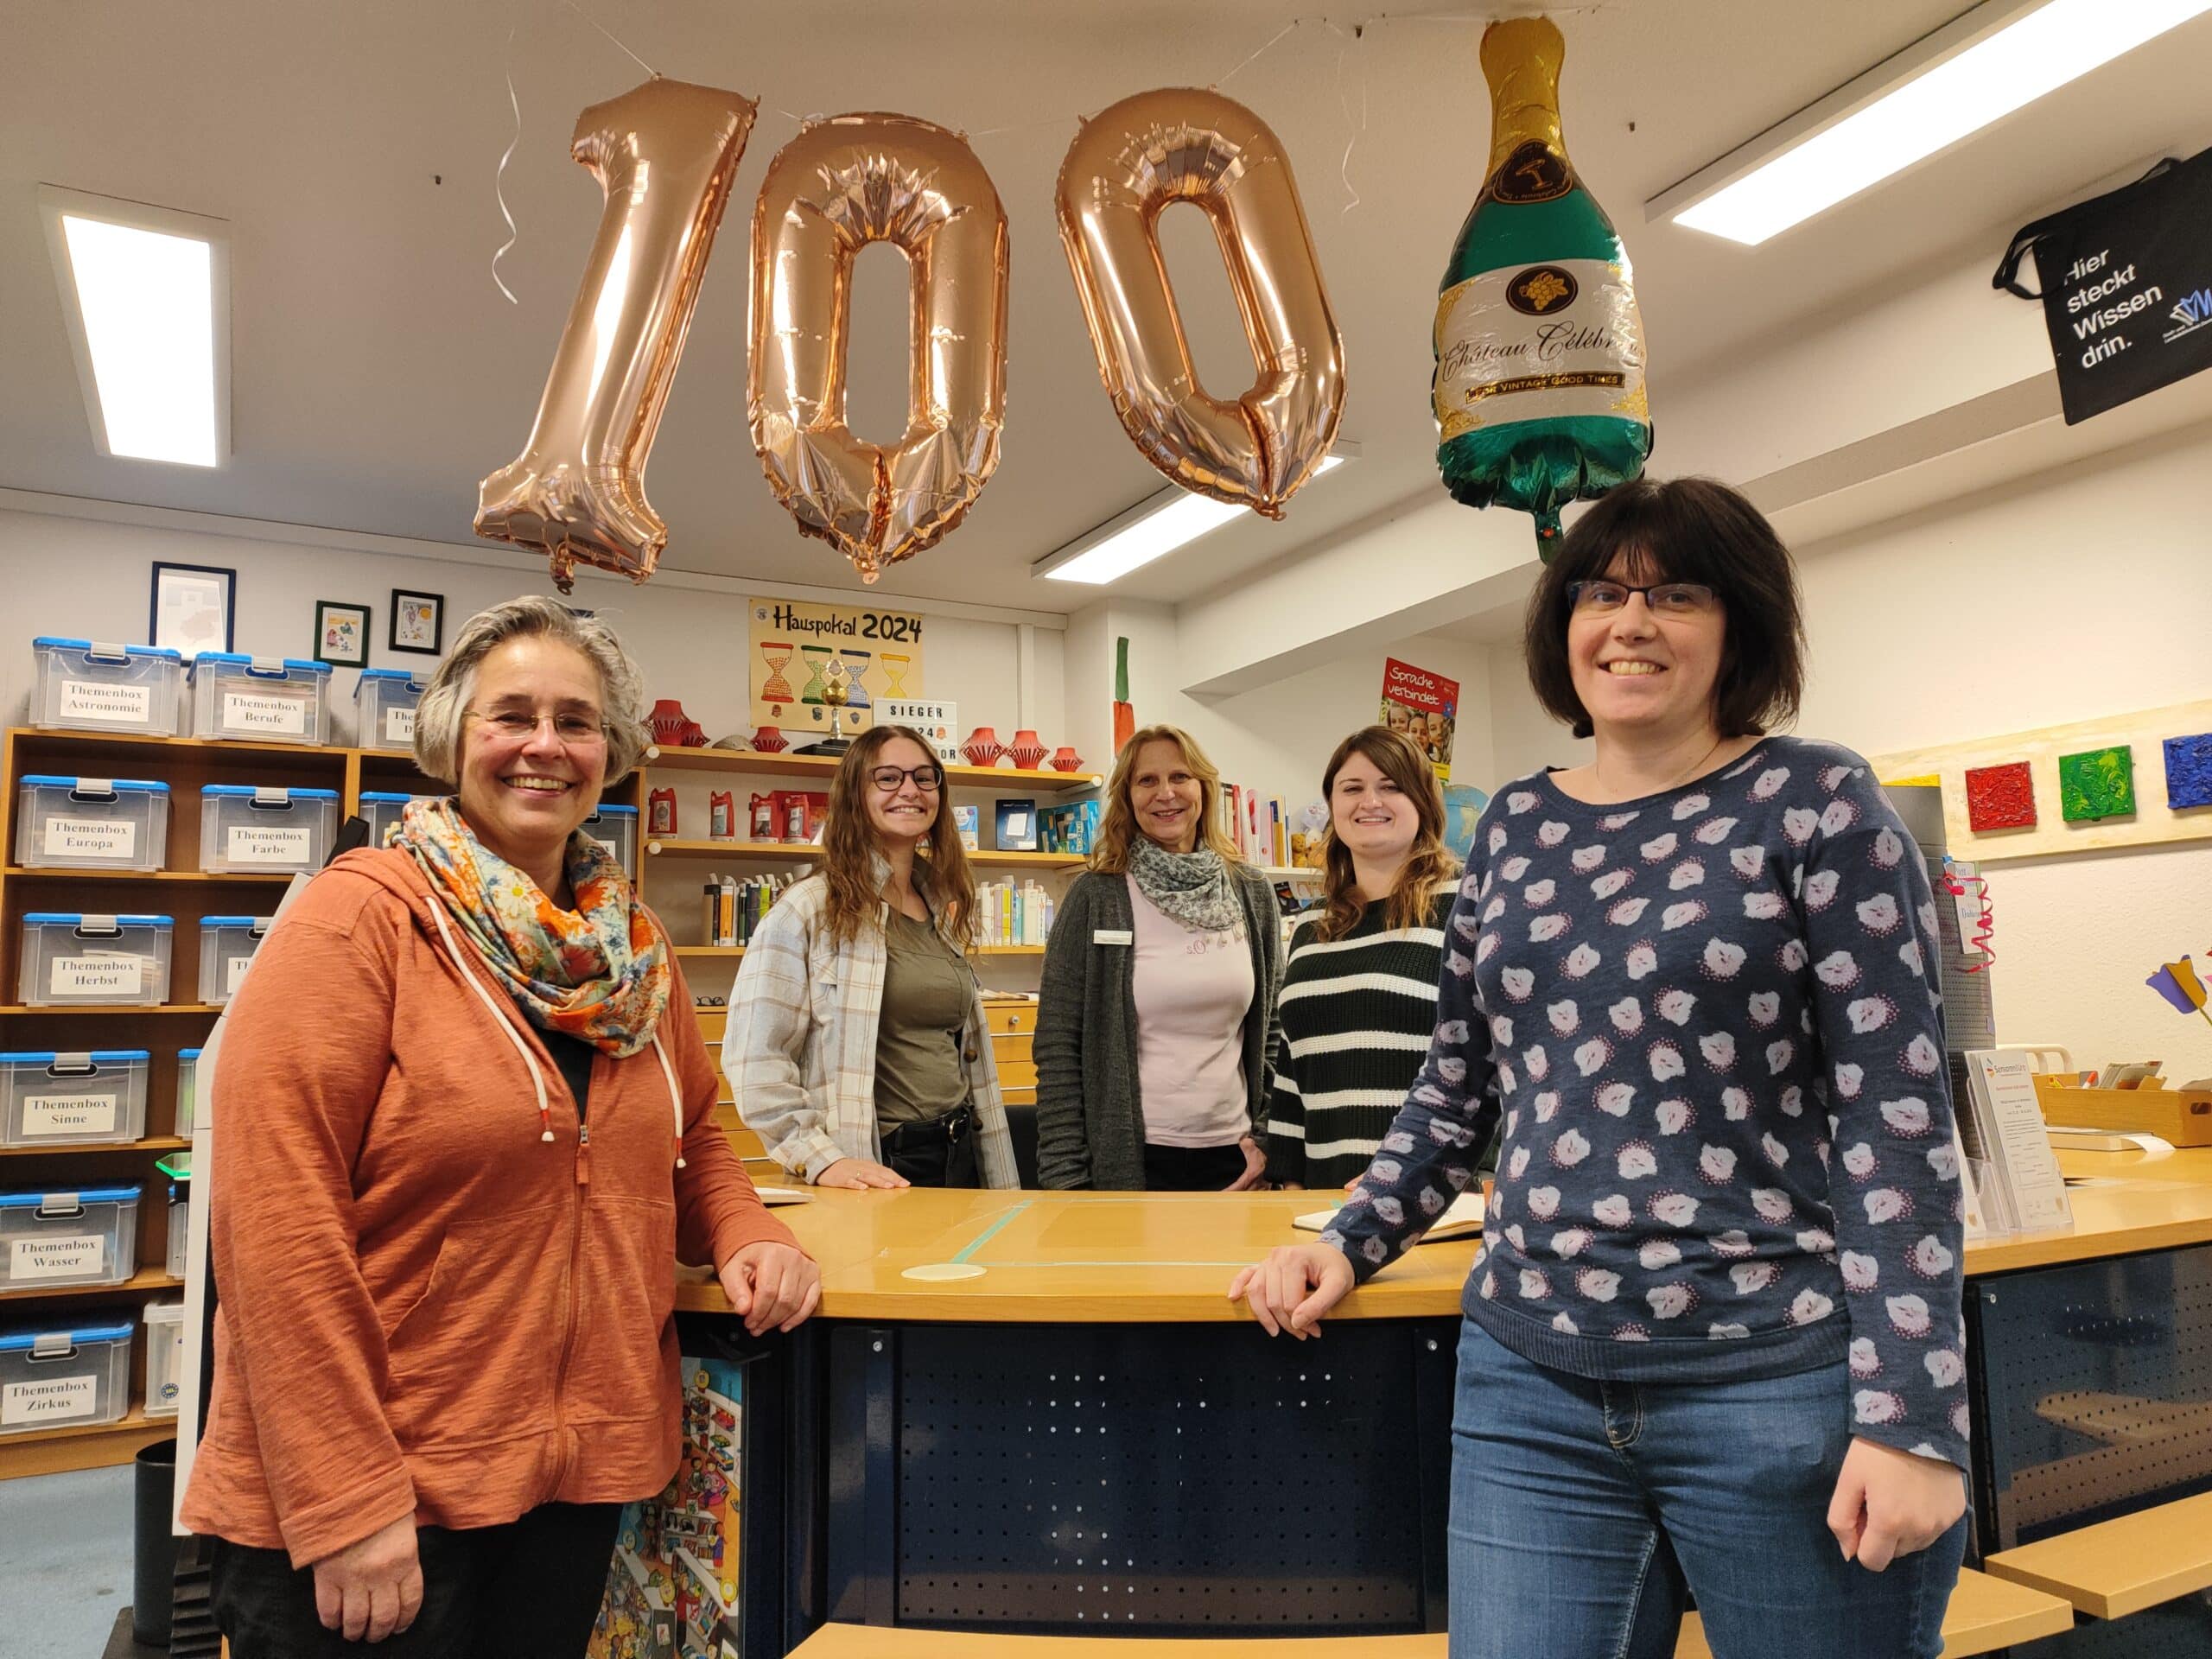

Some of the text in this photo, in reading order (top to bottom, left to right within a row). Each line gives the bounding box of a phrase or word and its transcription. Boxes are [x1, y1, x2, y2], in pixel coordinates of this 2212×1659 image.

[2063, 250, 2109, 286] Hier
[2067, 264, 2136, 314] steckt
[2073, 286, 2162, 340] Wissen
[2082, 335, 2133, 369] drin.
[1441, 340, 1528, 382] Château
[1551, 376, 1584, 385] GOOD
[772, 605, 856, 639] Hauspokal
[862, 613, 922, 643] 2024
[1389, 666, 1436, 690] Sprache
[68, 684, 143, 700] Themenbox
[1388, 683, 1440, 706] verbindet
[230, 696, 299, 712] Themenbox
[245, 711, 284, 725] Berufe
[890, 705, 943, 719] SIEGER
[53, 821, 128, 836] Themenbox
[66, 836, 114, 850] Europa
[234, 830, 303, 842] Themenbox
[251, 842, 287, 855] Farbe
[60, 960, 134, 971] Themenbox
[75, 975, 118, 985] Herbst
[32, 1098, 108, 1110] Themenbox
[51, 1113, 87, 1124] Sinne
[20, 1240, 97, 1254] Themenbox
[34, 1255, 81, 1268] Wasser
[12, 1381, 89, 1398] Themenbox
[27, 1398, 72, 1412] Zirkus
